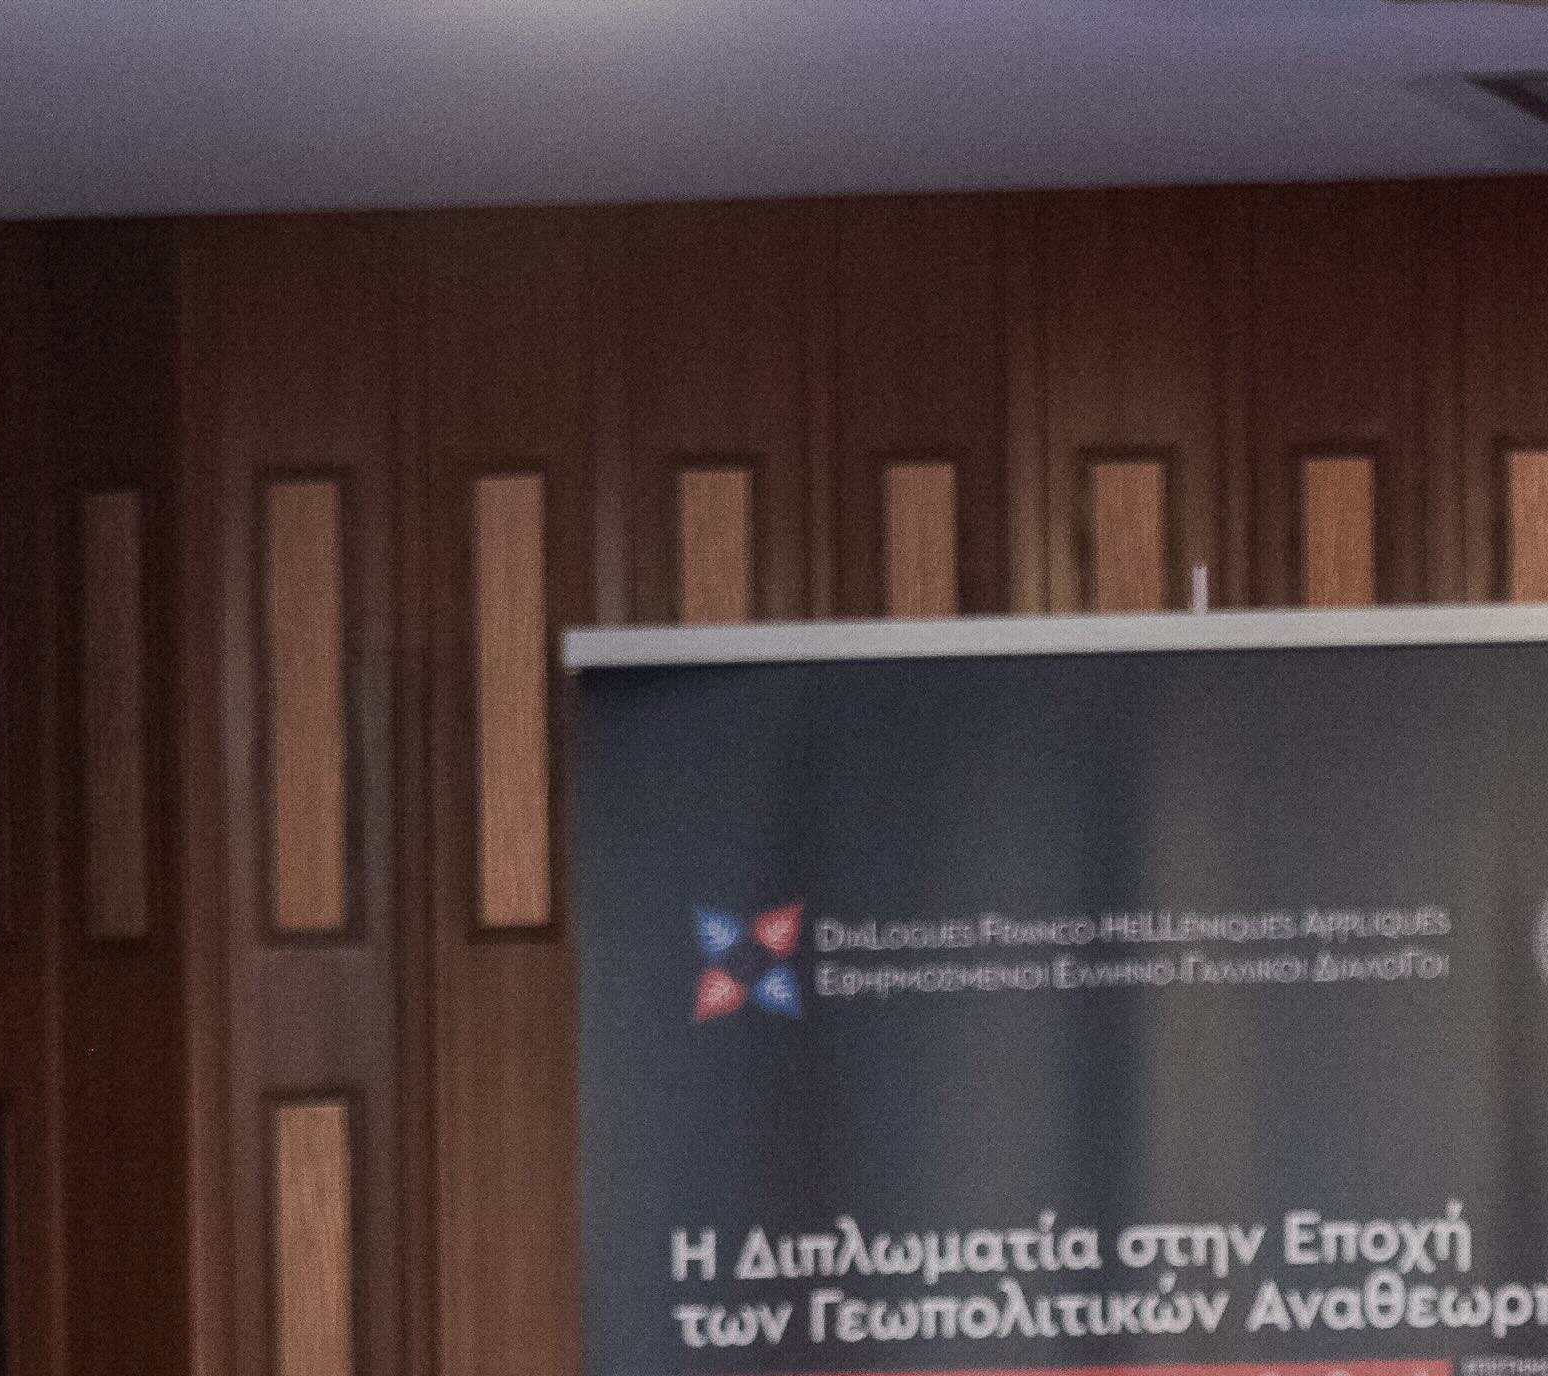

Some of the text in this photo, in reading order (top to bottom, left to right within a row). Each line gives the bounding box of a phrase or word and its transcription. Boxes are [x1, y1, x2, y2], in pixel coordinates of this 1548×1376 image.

[670, 1199, 1473, 1287] Η Διπλωματία στην Εποχή
[673, 1302, 793, 1348] των
[809, 1271, 1230, 1345] Γεωπολιτικών
